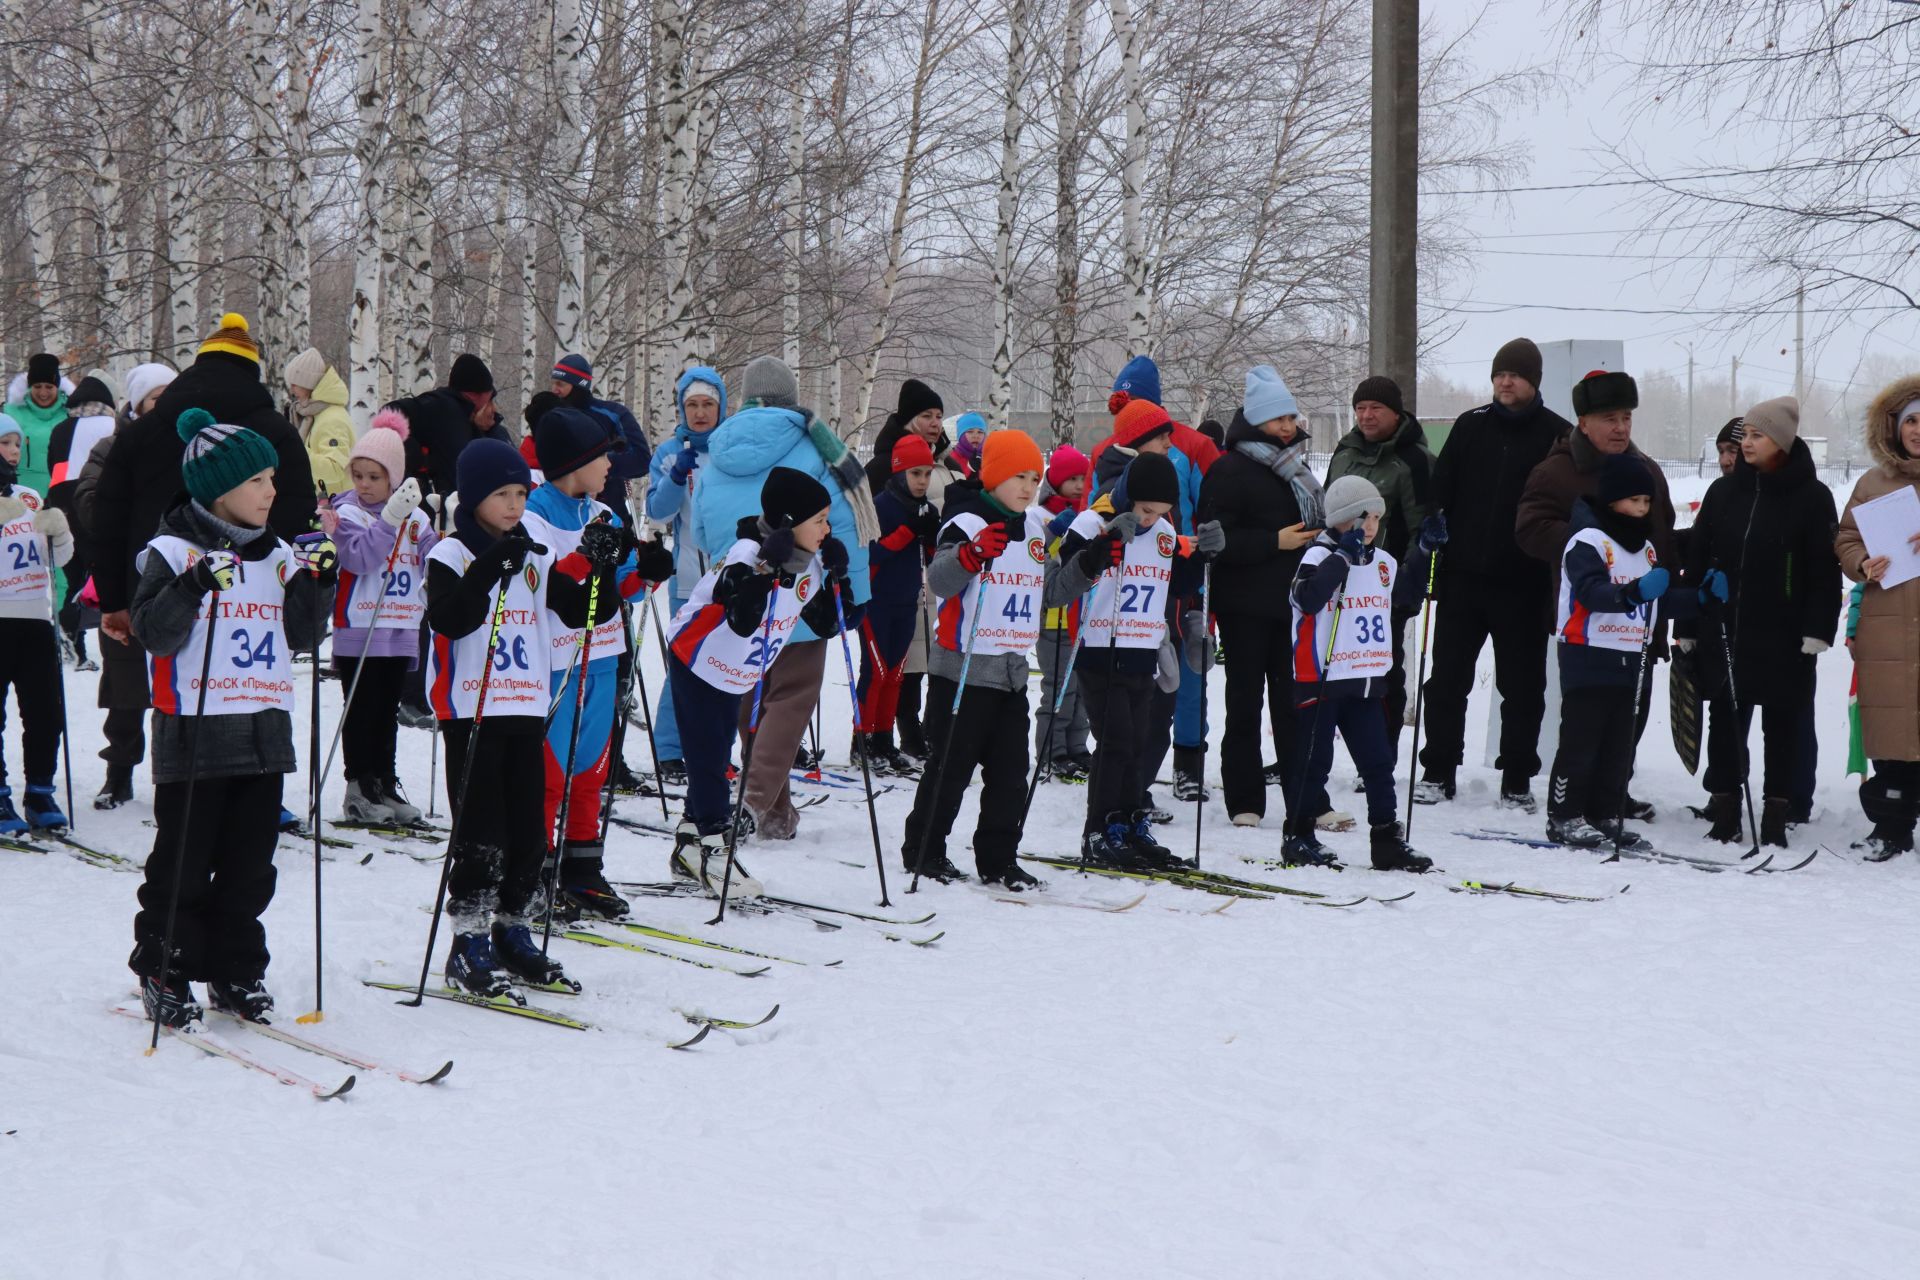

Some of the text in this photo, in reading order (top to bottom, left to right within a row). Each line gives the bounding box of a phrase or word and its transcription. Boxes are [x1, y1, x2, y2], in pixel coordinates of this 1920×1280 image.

[8, 540, 41, 570] 24
[381, 570, 411, 597] 29
[1120, 584, 1155, 613] 27
[1002, 593, 1032, 623] 44
[1355, 614, 1386, 644] 38
[231, 628, 276, 670] 34
[493, 634, 529, 671] 36
[744, 636, 782, 666] 26
